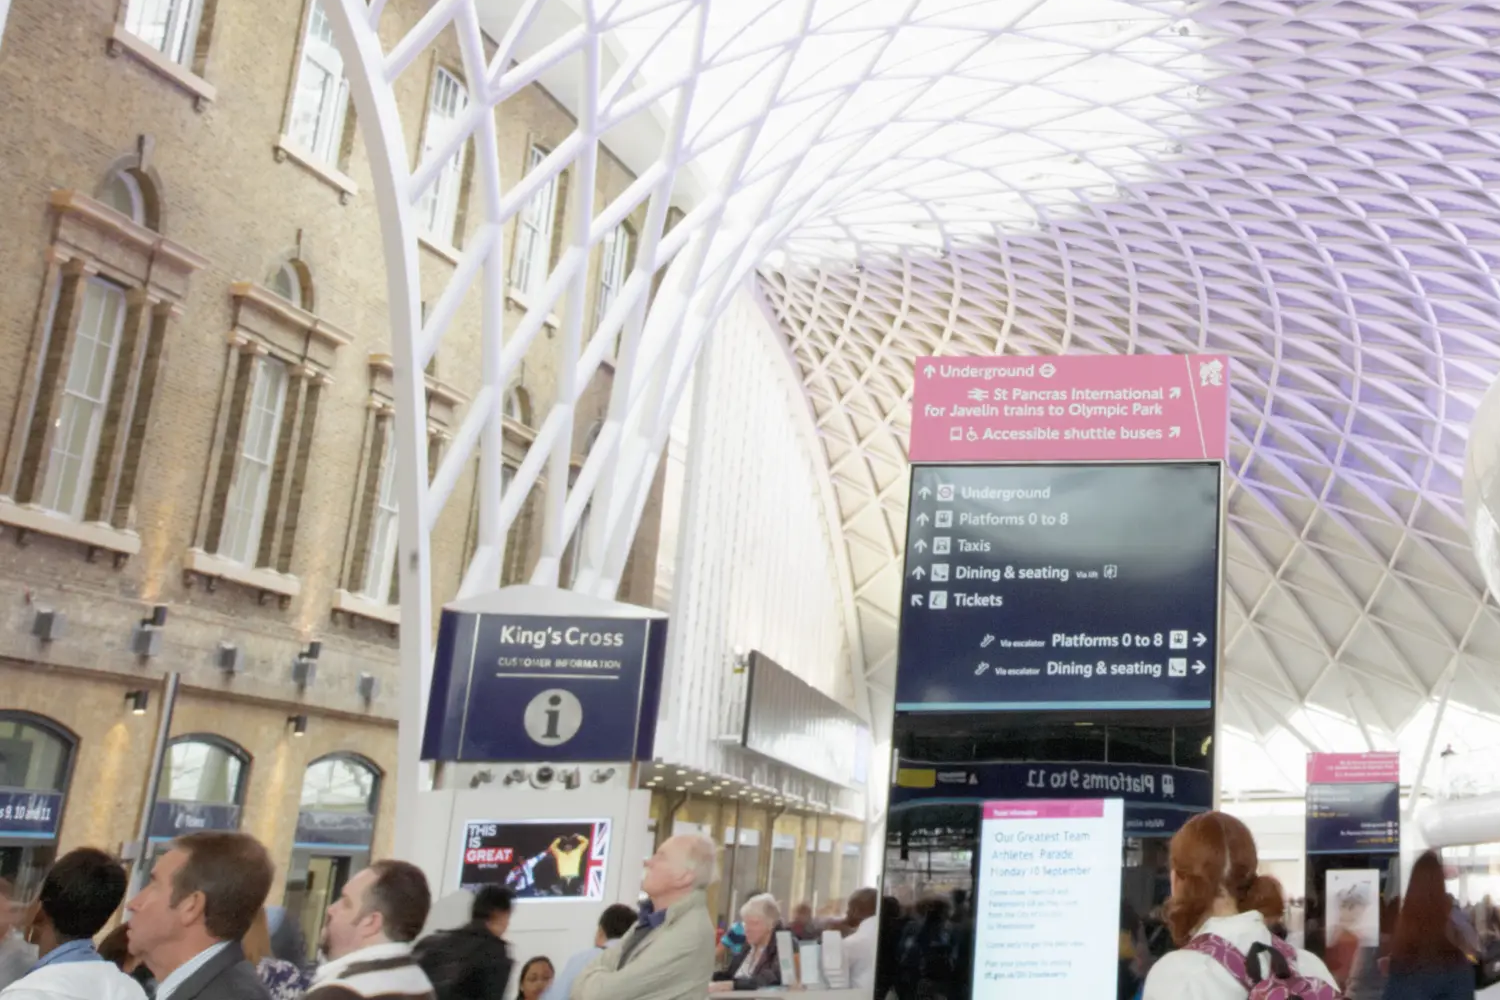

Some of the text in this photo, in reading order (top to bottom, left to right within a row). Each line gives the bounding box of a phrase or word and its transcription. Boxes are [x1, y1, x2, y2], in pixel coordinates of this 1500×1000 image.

[940, 364, 1034, 379] Underground
[993, 387, 1163, 401] St Pancras International
[924, 403, 1163, 418] for Javelin trains to Olympic Park
[982, 427, 1163, 440] Accessible shuttle buses
[961, 486, 1051, 502] Underground
[959, 513, 1069, 526] Platforms 0 to 8
[957, 539, 991, 552] Taxis
[955, 566, 1001, 582] Dining
[1004, 565, 1015, 579] &
[1018, 566, 1069, 581] seating
[953, 593, 1003, 607] Tickets
[500, 625, 624, 649] King's Cross
[1052, 633, 1119, 647] Platforms
[1122, 633, 1131, 647] 0
[1135, 635, 1150, 647] to
[1153, 634, 1163, 647] 8
[498, 657, 621, 669] CUSTOMER INFORMATION
[1047, 661, 1093, 678] Dining
[1095, 661, 1107, 675] &
[1110, 661, 1162, 678] seating
[469, 824, 497, 836] THIS
[994, 830, 1090, 843] Our Greatest Team
[469, 836, 481, 848] IS
[466, 849, 513, 862] GREAT
